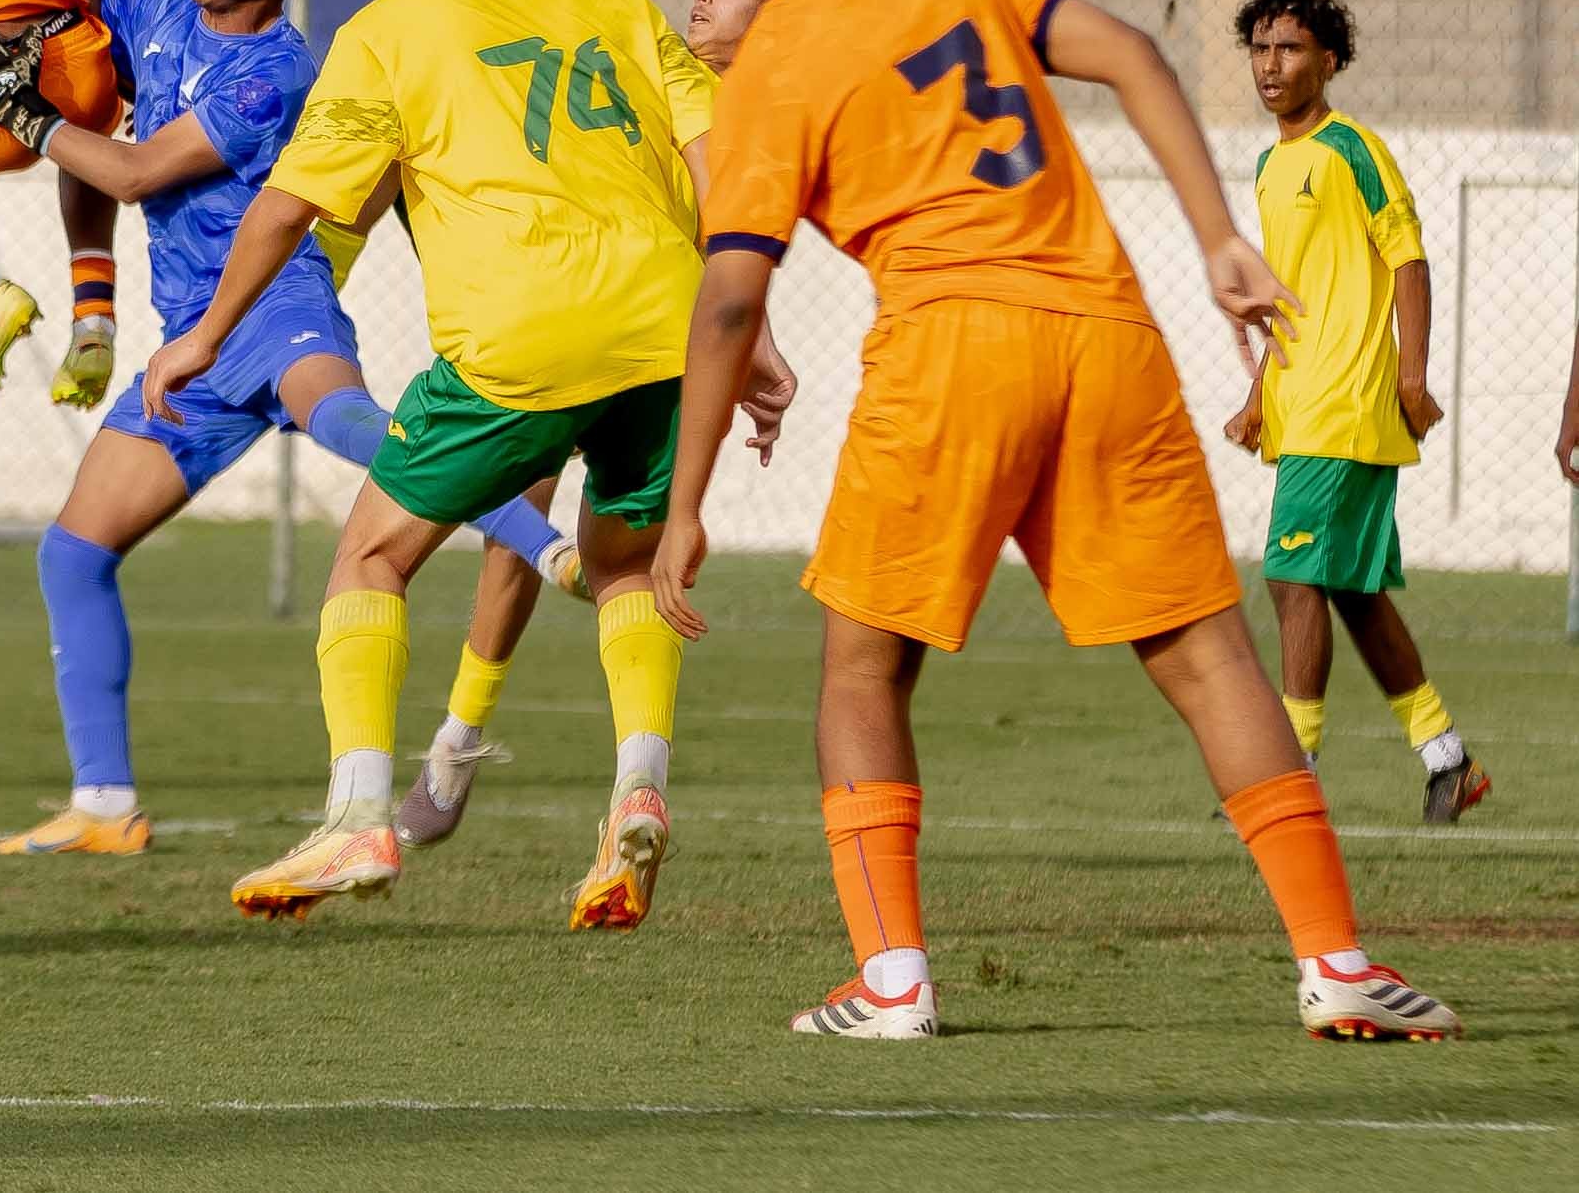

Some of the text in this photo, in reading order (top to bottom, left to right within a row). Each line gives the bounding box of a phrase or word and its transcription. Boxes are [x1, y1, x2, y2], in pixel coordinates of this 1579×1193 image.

[44, 11, 74, 38] NIKE
[476, 36, 643, 165] 74
[895, 19, 1046, 189] 3
